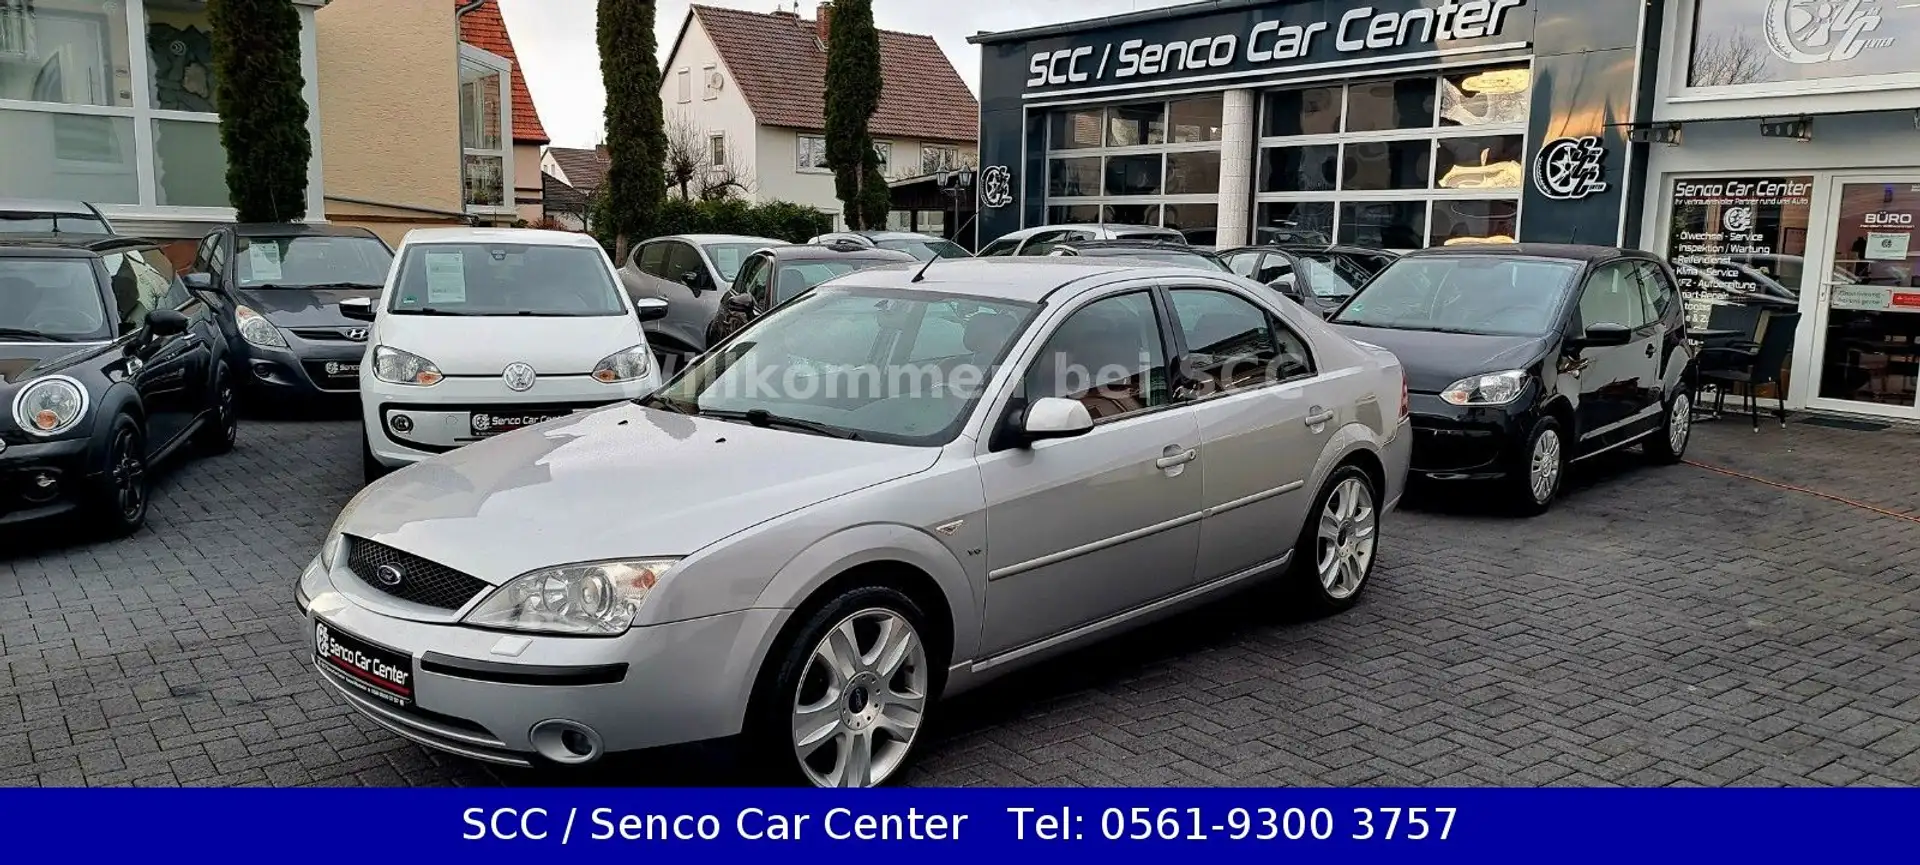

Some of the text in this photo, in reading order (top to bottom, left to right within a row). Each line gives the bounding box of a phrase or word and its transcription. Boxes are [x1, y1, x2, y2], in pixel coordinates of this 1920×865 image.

[1027, 0, 1520, 87] SCC / Senco Car Center
[1674, 180, 1811, 197] Senco Car Center
[1865, 211, 1912, 224] BÜRO
[1730, 232, 1763, 241] Service
[1679, 244, 1724, 254] Inspektion
[1731, 245, 1770, 255] Wartung
[1676, 267, 1739, 277] Klima Service
[491, 416, 521, 426] Senco
[522, 415, 539, 425] Car
[330, 637, 354, 664] Senco
[355, 650, 371, 671] Car
[373, 658, 409, 686] Center
